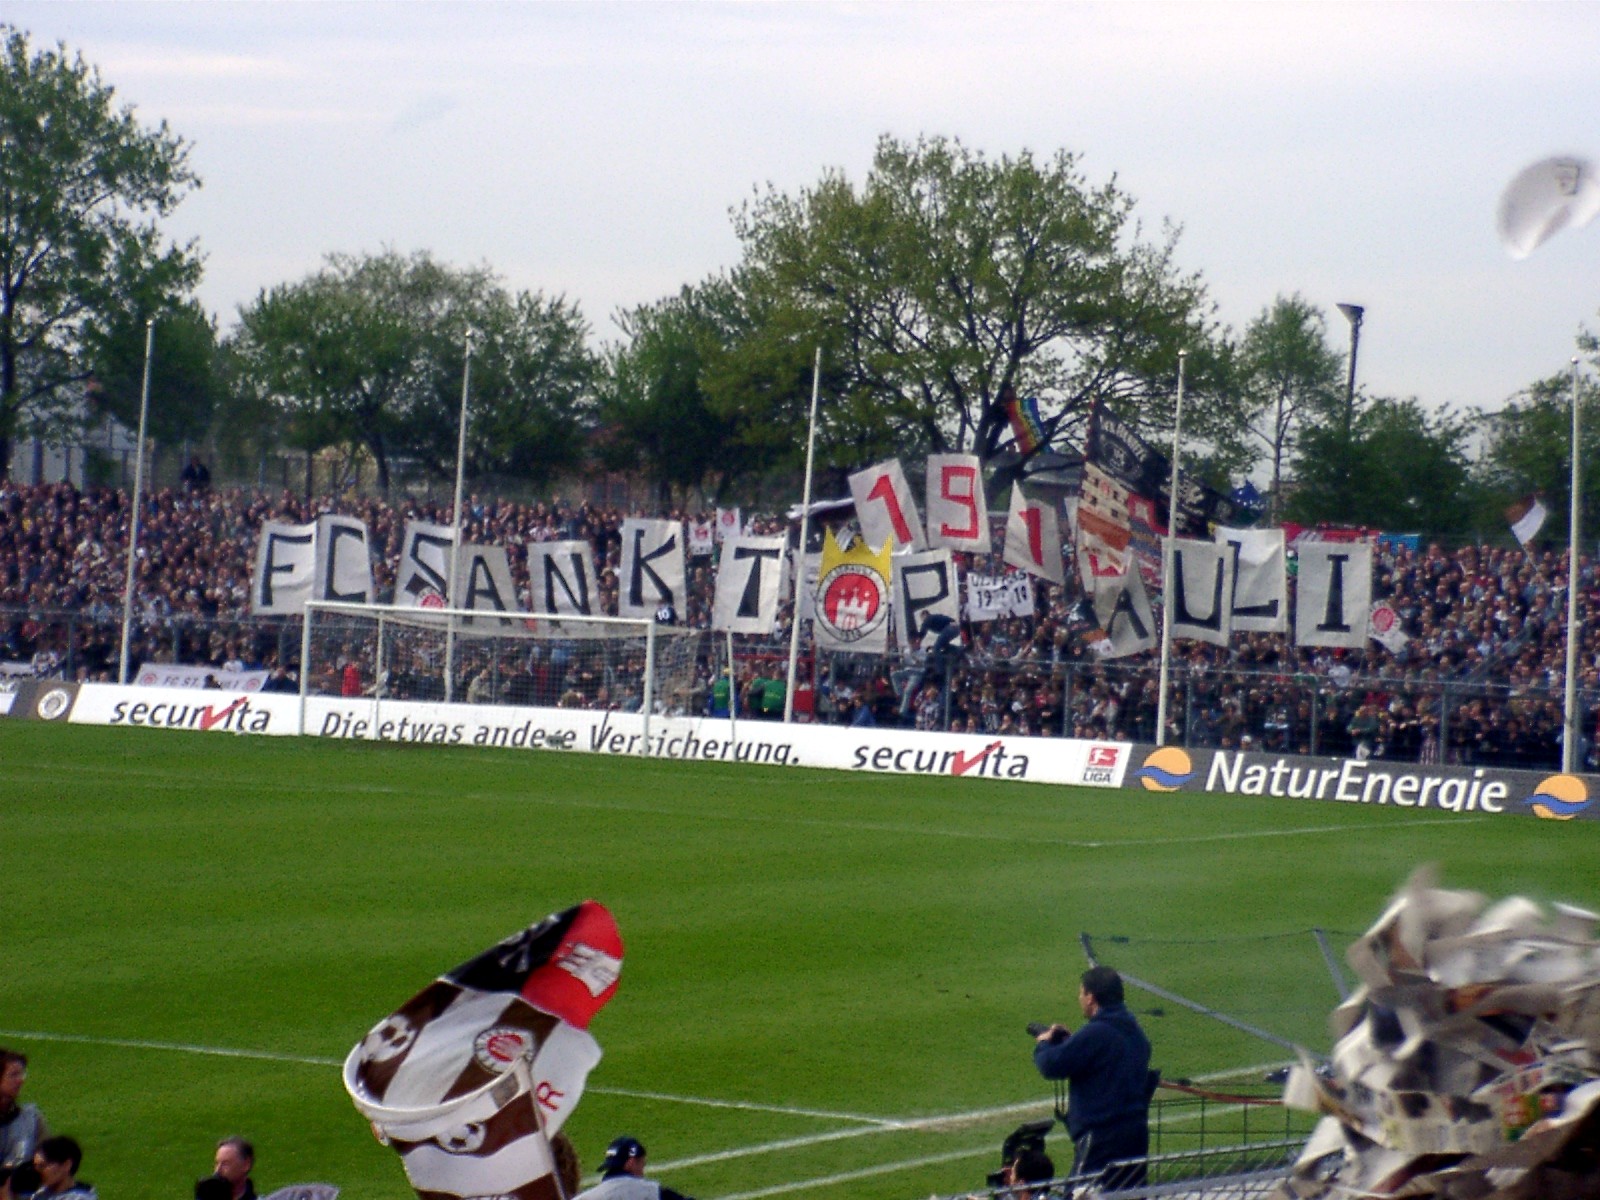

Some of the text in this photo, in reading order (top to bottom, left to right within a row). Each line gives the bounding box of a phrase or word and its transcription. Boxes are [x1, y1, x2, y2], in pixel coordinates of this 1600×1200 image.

[260, 525, 1350, 642] FC SANKT PAULI
[321, 712, 367, 738] Die
[379, 717, 464, 744] etwas
[473, 720, 576, 749] andee
[1083, 772, 1111, 783] LIGA
[1205, 751, 1507, 812] NaturEnergie
